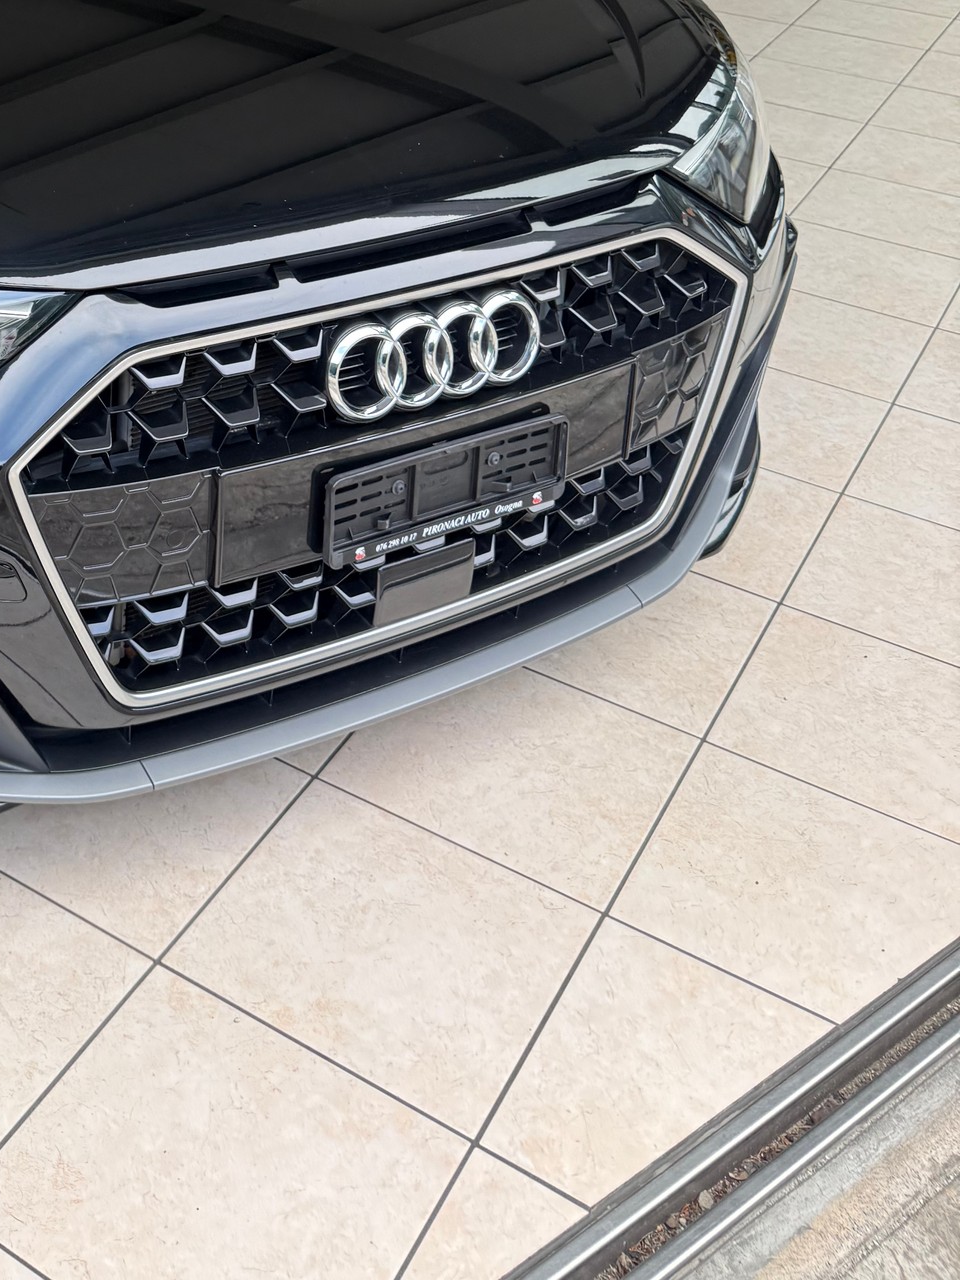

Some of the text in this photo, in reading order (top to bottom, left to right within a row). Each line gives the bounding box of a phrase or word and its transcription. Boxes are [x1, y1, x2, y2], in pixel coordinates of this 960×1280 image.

[376, 541, 388, 552] 076
[400, 535, 409, 544] 10
[409, 532, 418, 542] 17
[465, 508, 490, 523] AUTO
[494, 500, 522, 515] Osogna
